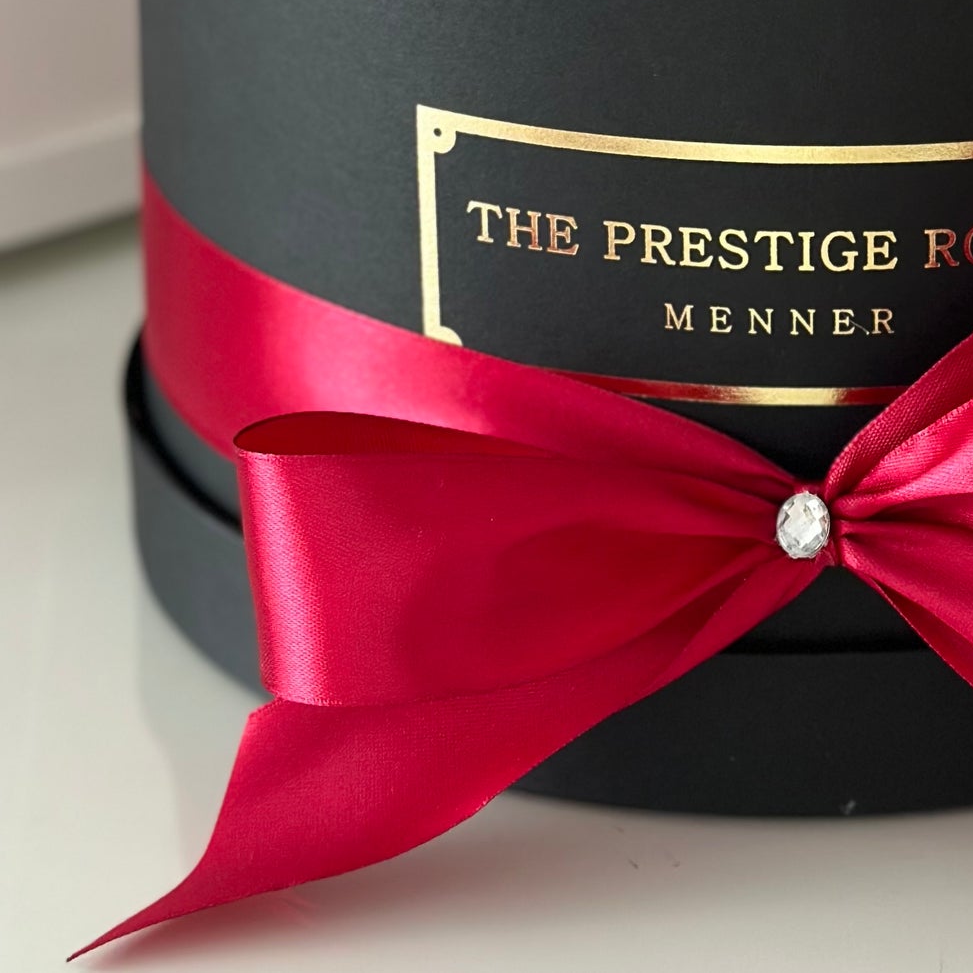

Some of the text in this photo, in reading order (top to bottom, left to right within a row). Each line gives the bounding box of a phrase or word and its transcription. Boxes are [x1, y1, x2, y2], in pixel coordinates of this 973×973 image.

[467, 200, 580, 256] THE
[603, 220, 898, 272] PRESTIGE
[664, 302, 895, 336] MENNER
